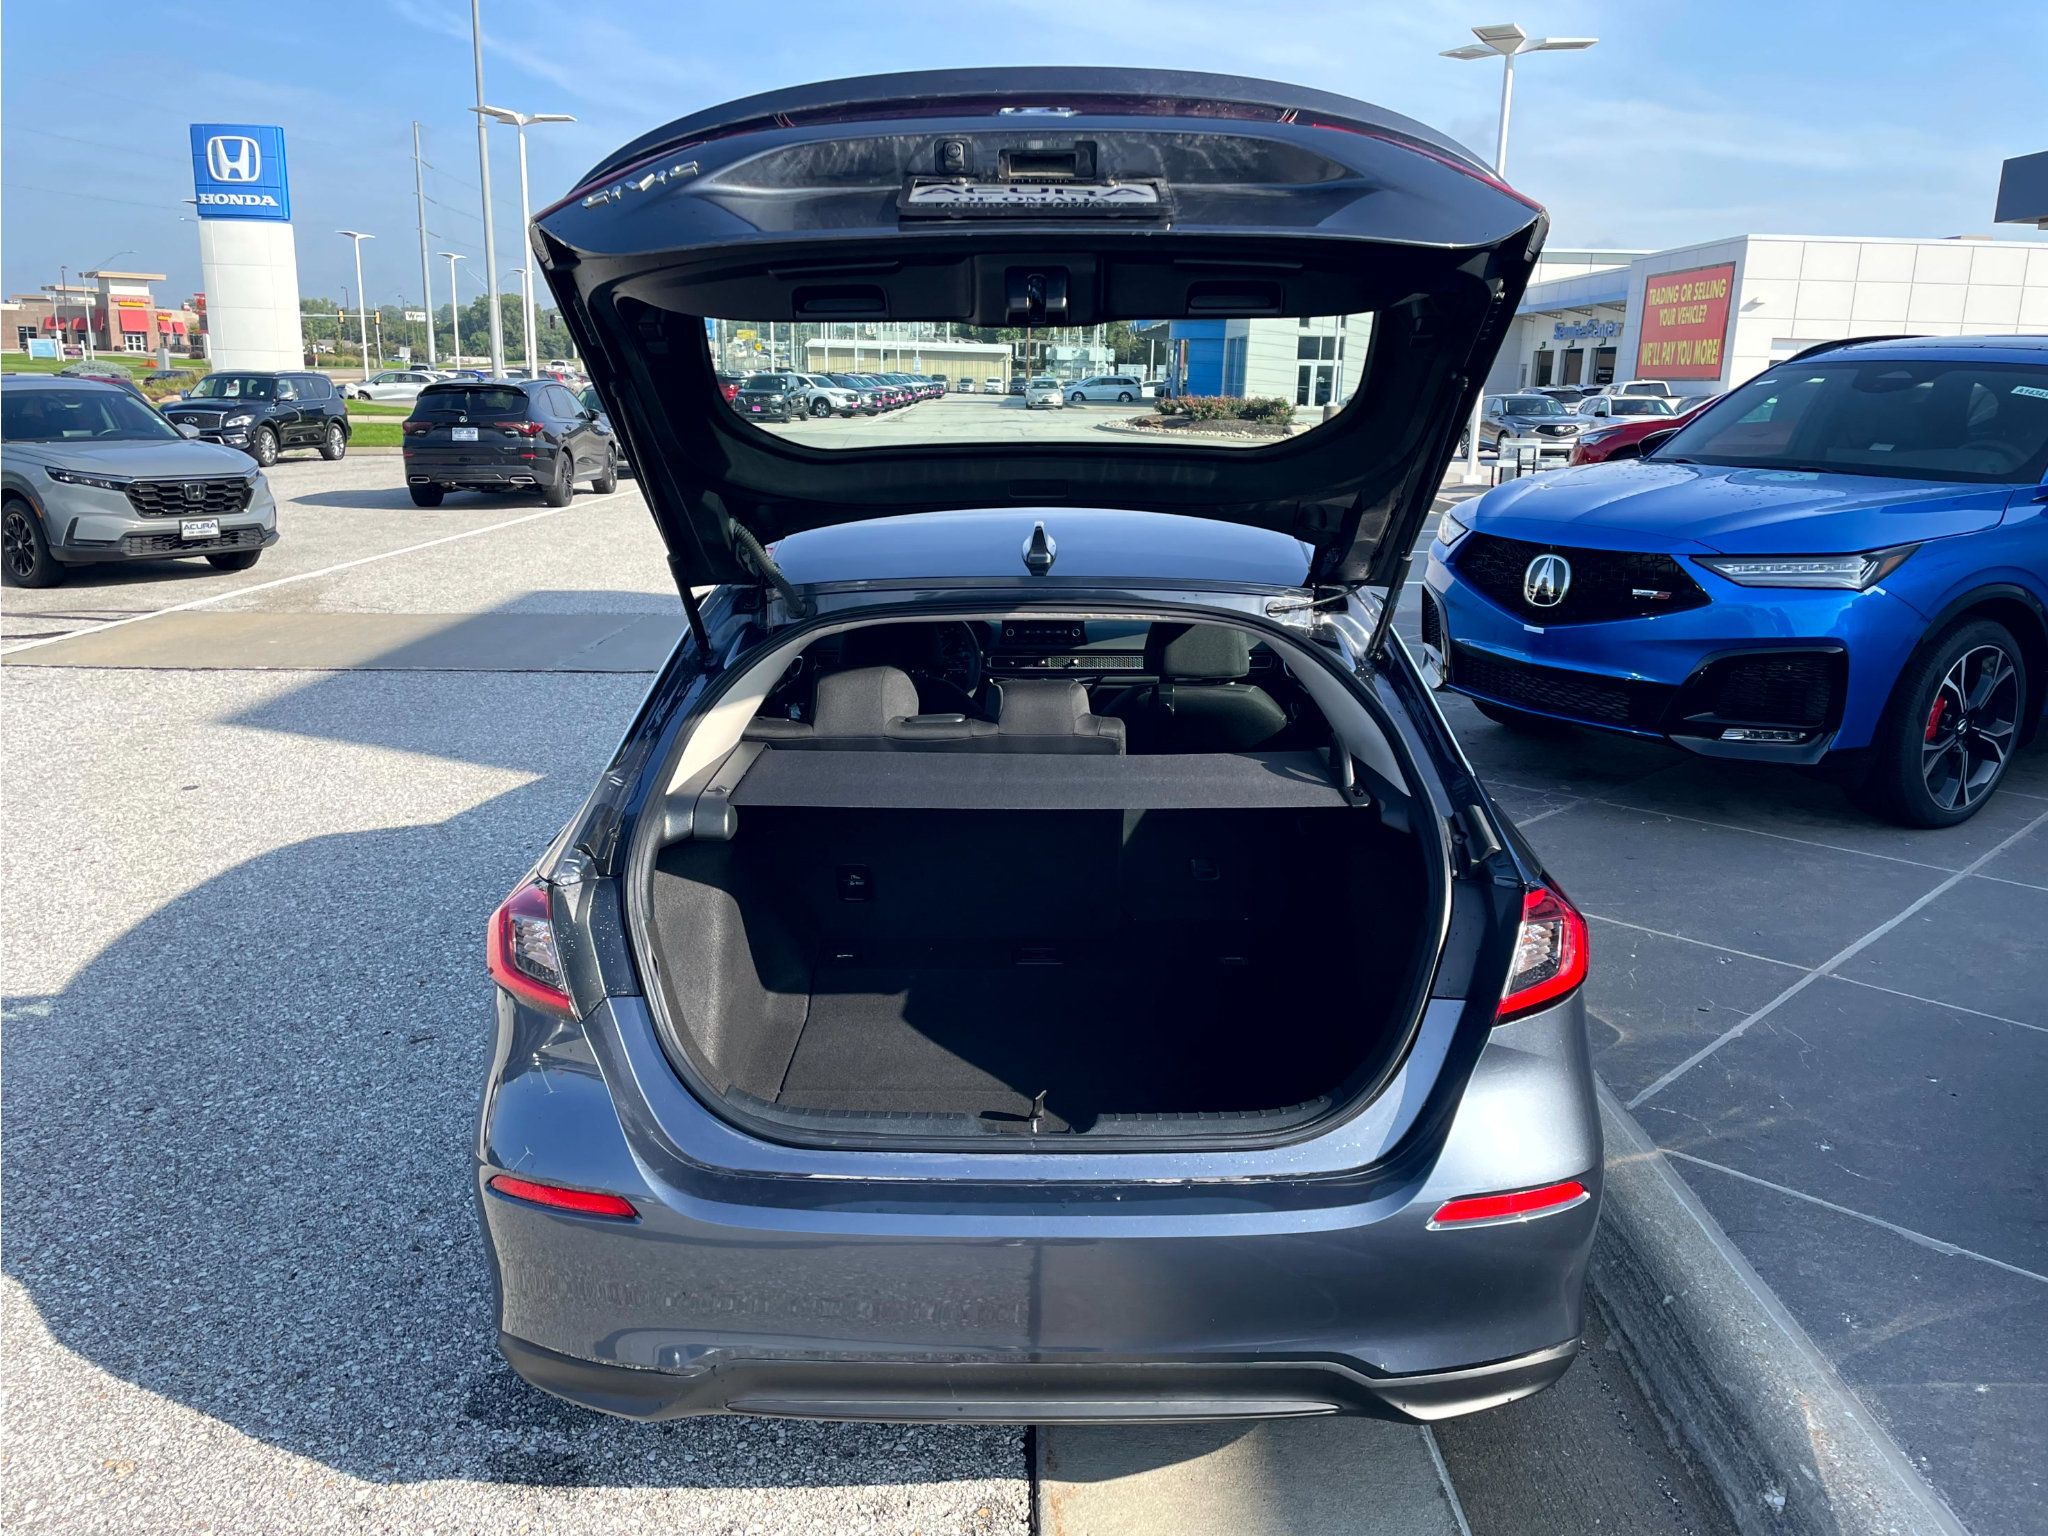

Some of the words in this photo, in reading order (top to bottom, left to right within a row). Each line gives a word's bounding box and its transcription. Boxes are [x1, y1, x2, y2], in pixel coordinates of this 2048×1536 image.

[198, 193, 279, 207] HONDA
[1648, 285, 1680, 306] TRADING
[1681, 283, 1693, 302] OR
[1693, 278, 1727, 300] SELLING
[1660, 307, 1677, 327] YOUR
[1677, 304, 1708, 325] VEHICLE?
[1642, 342, 1661, 366] WE'LL
[1661, 341, 1676, 366] PAY
[1676, 340, 1694, 366] YOU
[1694, 338, 1721, 365] MORE!
[183, 522, 217, 530] ACURA
